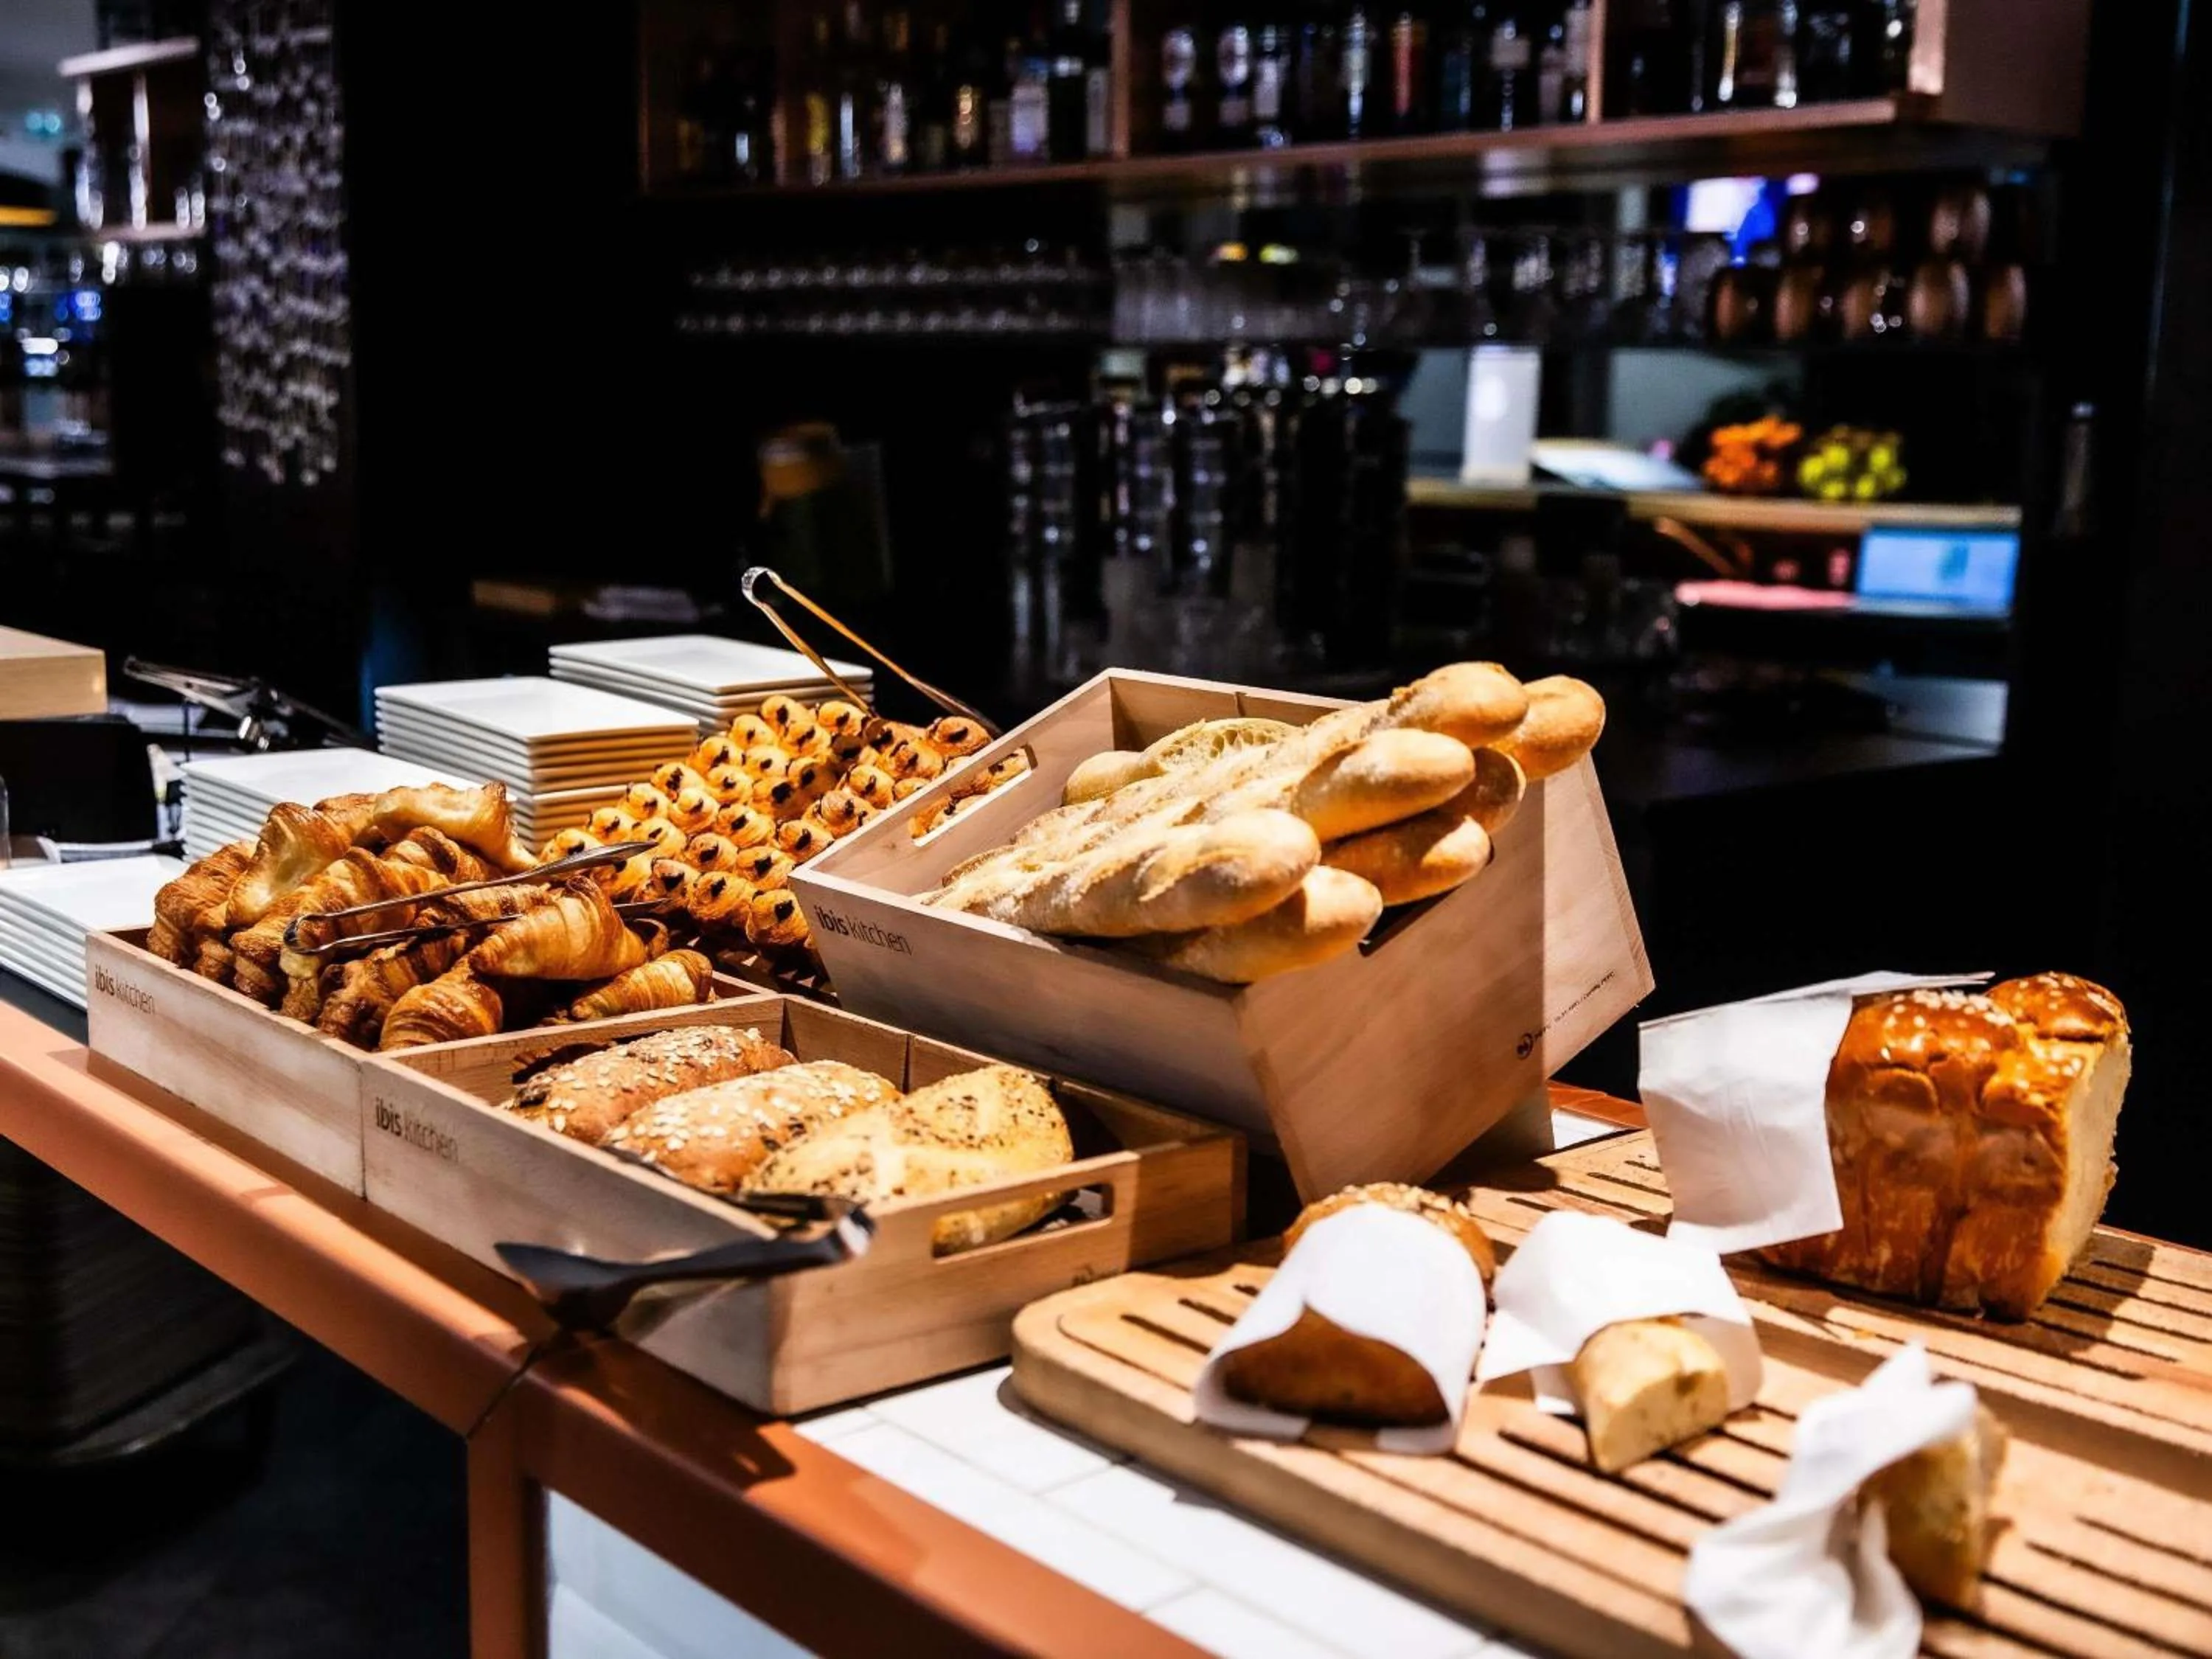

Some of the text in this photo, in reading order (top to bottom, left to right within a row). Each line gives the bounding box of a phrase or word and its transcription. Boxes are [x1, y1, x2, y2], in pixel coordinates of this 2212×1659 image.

[813, 905, 914, 956] ibis kitchen
[95, 964, 156, 1015] ibis kitchen
[375, 1096, 459, 1164] ibis kitchen
